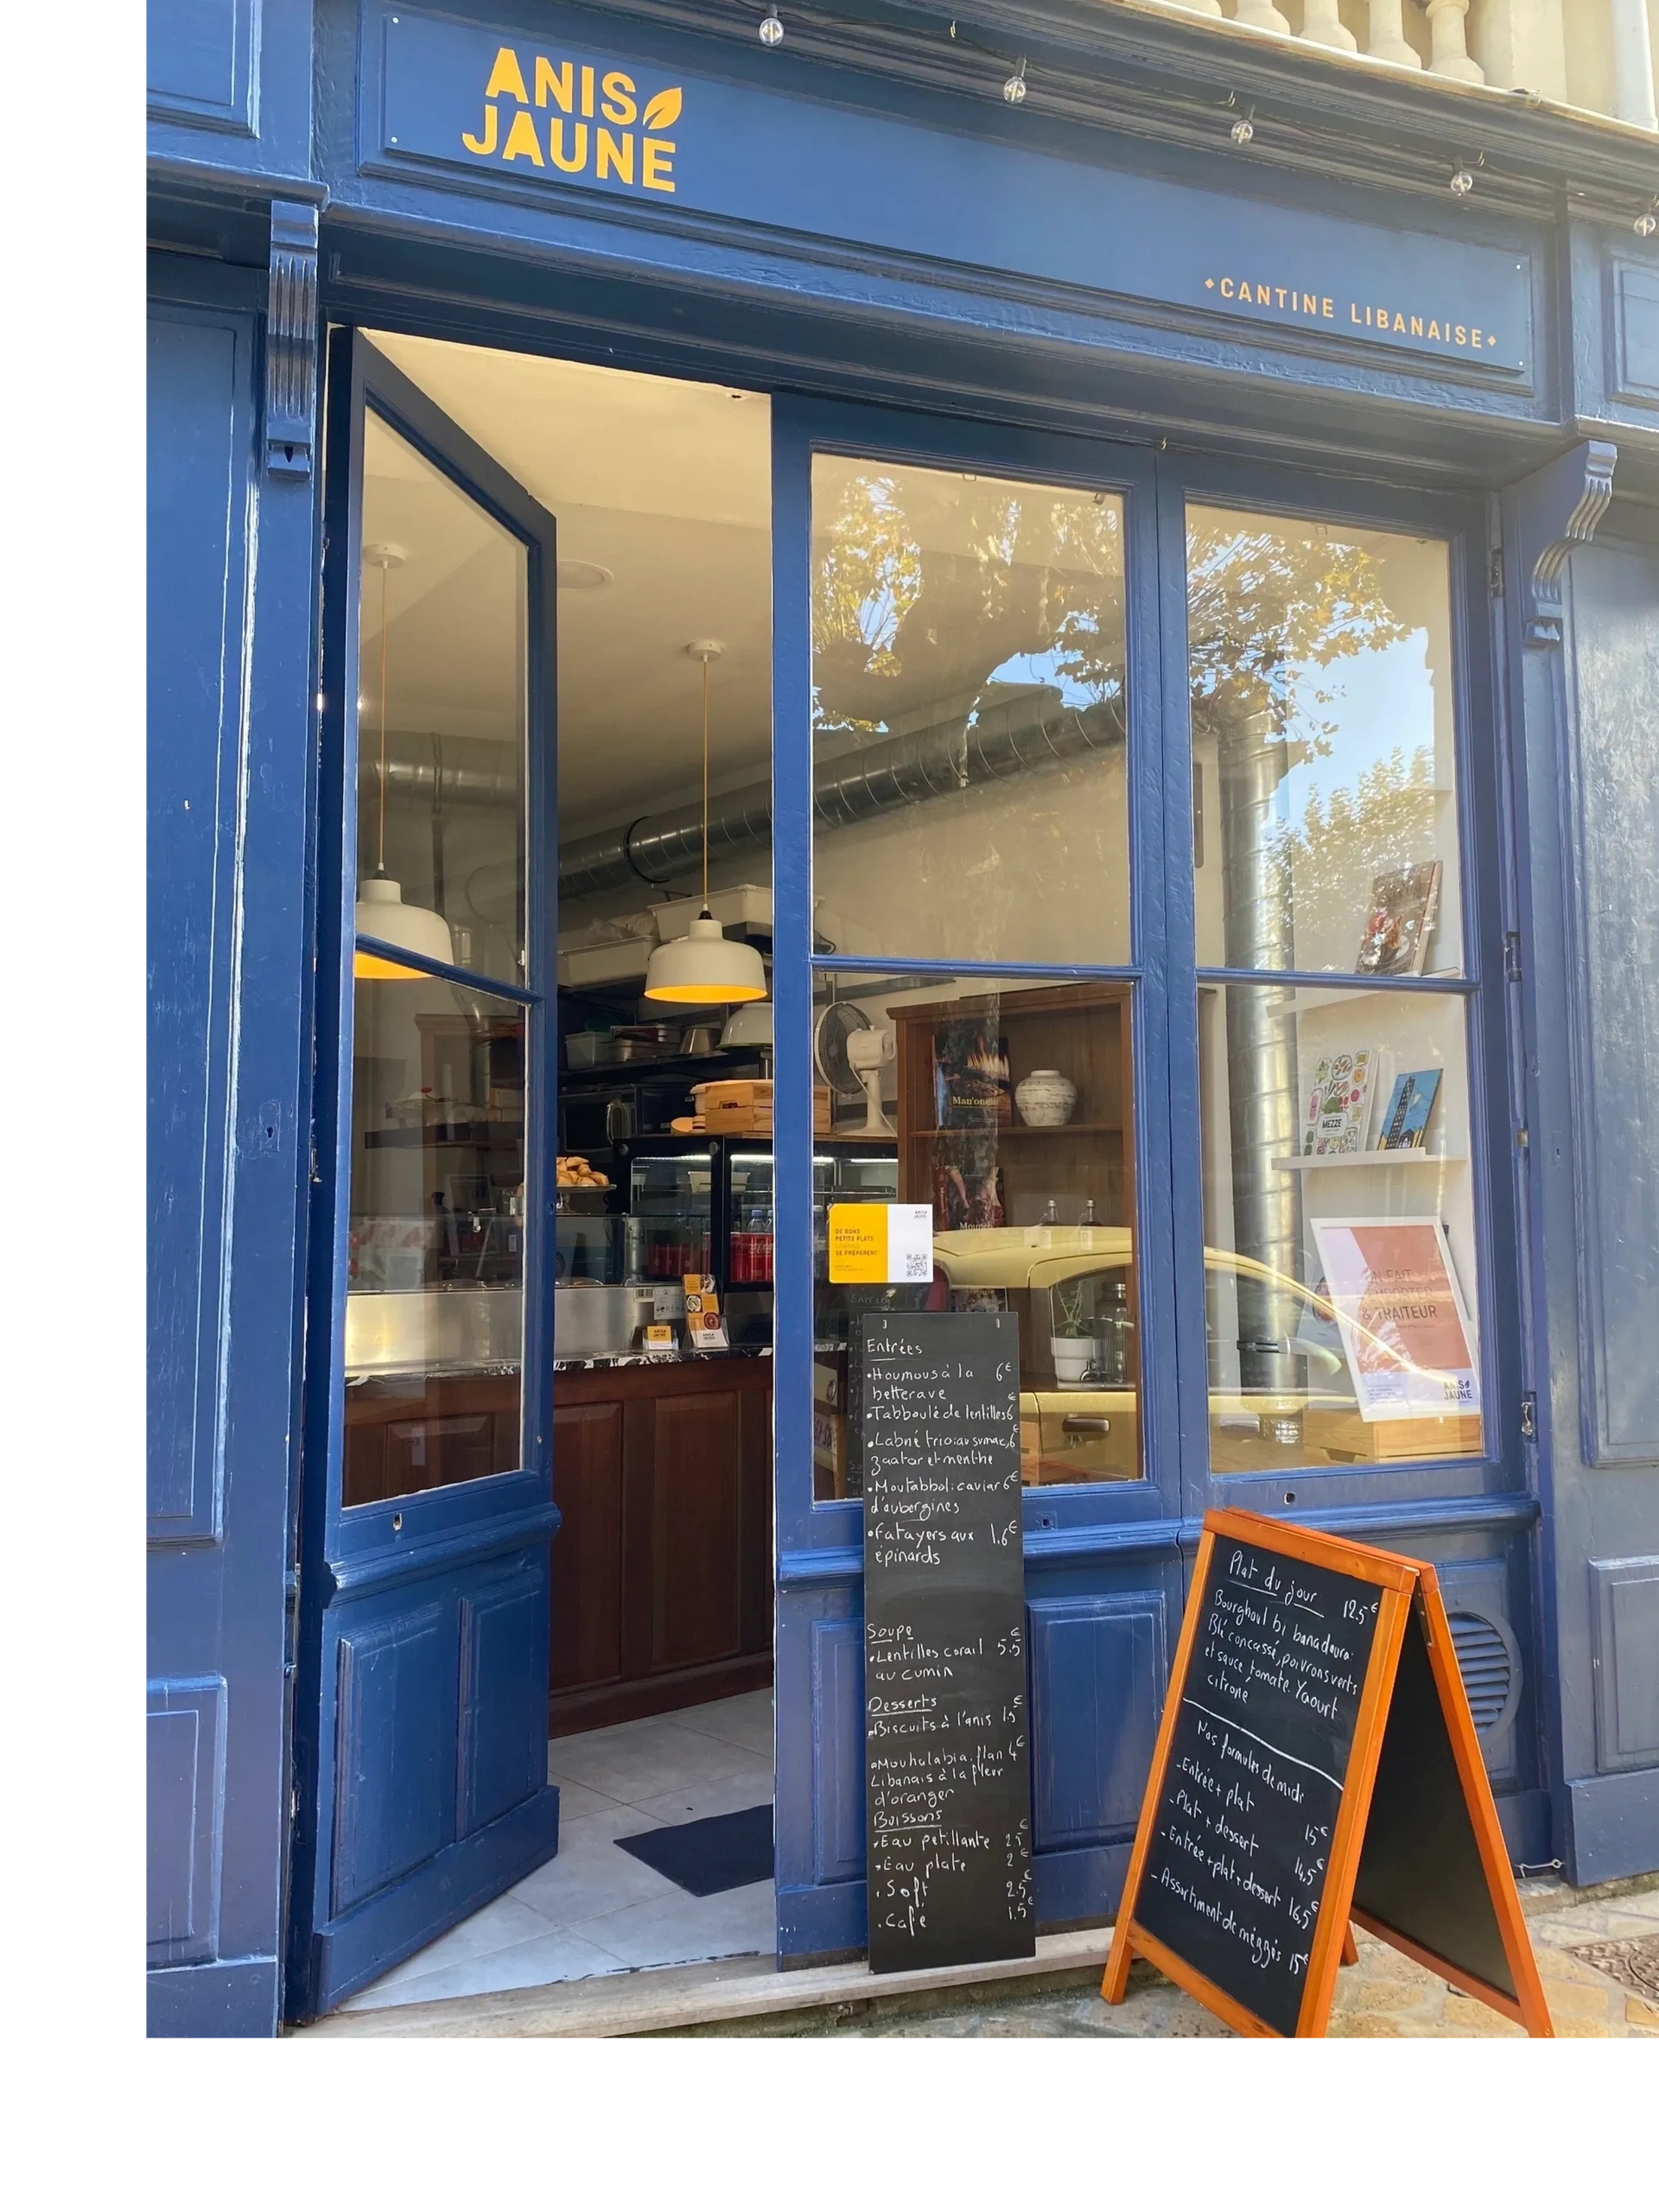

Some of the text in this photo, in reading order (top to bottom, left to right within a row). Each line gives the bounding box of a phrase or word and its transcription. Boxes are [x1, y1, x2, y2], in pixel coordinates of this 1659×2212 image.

[485, 47, 638, 126] ANIS
[461, 104, 677, 193] JAUNE
[1220, 276, 1483, 349] CANTINE LIBANAISE
[1322, 1119, 1342, 1129] MEZZE
[1387, 1269, 1411, 1282] FAIT
[1375, 1305, 1438, 1320] TRAITEUR
[867, 1338, 923, 1356] Entrées
[958, 1363, 974, 1378] la
[873, 1384, 947, 1401] betterave
[1444, 1389, 1473, 1401] JAUNE
[870, 1404, 939, 1421] Tabboulé
[943, 1403, 961, 1419] de
[875, 1430, 921, 1448] Labné
[943, 1450, 993, 1465] menthe
[957, 1479, 1000, 1492] caviar
[871, 1496, 960, 1522] d'aubergines
[950, 1531, 974, 1542] aux
[875, 1545, 941, 1567] épinards
[1230, 1550, 1318, 1606] Plat du jour
[1214, 1589, 1268, 1625] Bourghoul
[1272, 1613, 1287, 1637] bi
[867, 1624, 912, 1641] Soupe
[877, 1643, 938, 1662] Lentilles
[944, 1637, 982, 1657] corail
[1209, 1612, 1228, 1638] Blé
[1281, 1653, 1329, 1683] poivrons
[1331, 1674, 1357, 1695] verts
[875, 1664, 954, 1681] au cumin
[1205, 1640, 1215, 1658] et
[1217, 1651, 1243, 1673] sauce
[1296, 1680, 1338, 1720] Yaourt
[868, 1694, 937, 1713] Desserts
[874, 1715, 936, 1737] Biscuits
[941, 1714, 950, 1729] à
[957, 1710, 992, 1727] l'anis
[1198, 1719, 1304, 1804] Nos formules de midi
[870, 1772, 933, 1788] Libanais
[938, 1768, 947, 1782] à
[952, 1767, 967, 1780] la
[874, 1789, 955, 1808] d'oranger
[1226, 1782, 1255, 1812] plat
[881, 1834, 912, 1847] Eau
[1215, 1815, 1259, 1857] dessert
[884, 1856, 914, 1872] Eau
[925, 1853, 966, 1879] plate
[887, 1876, 929, 1908] Soft
[1161, 1867, 1223, 1923] Assortiment
[1222, 1910, 1236, 1935] de
